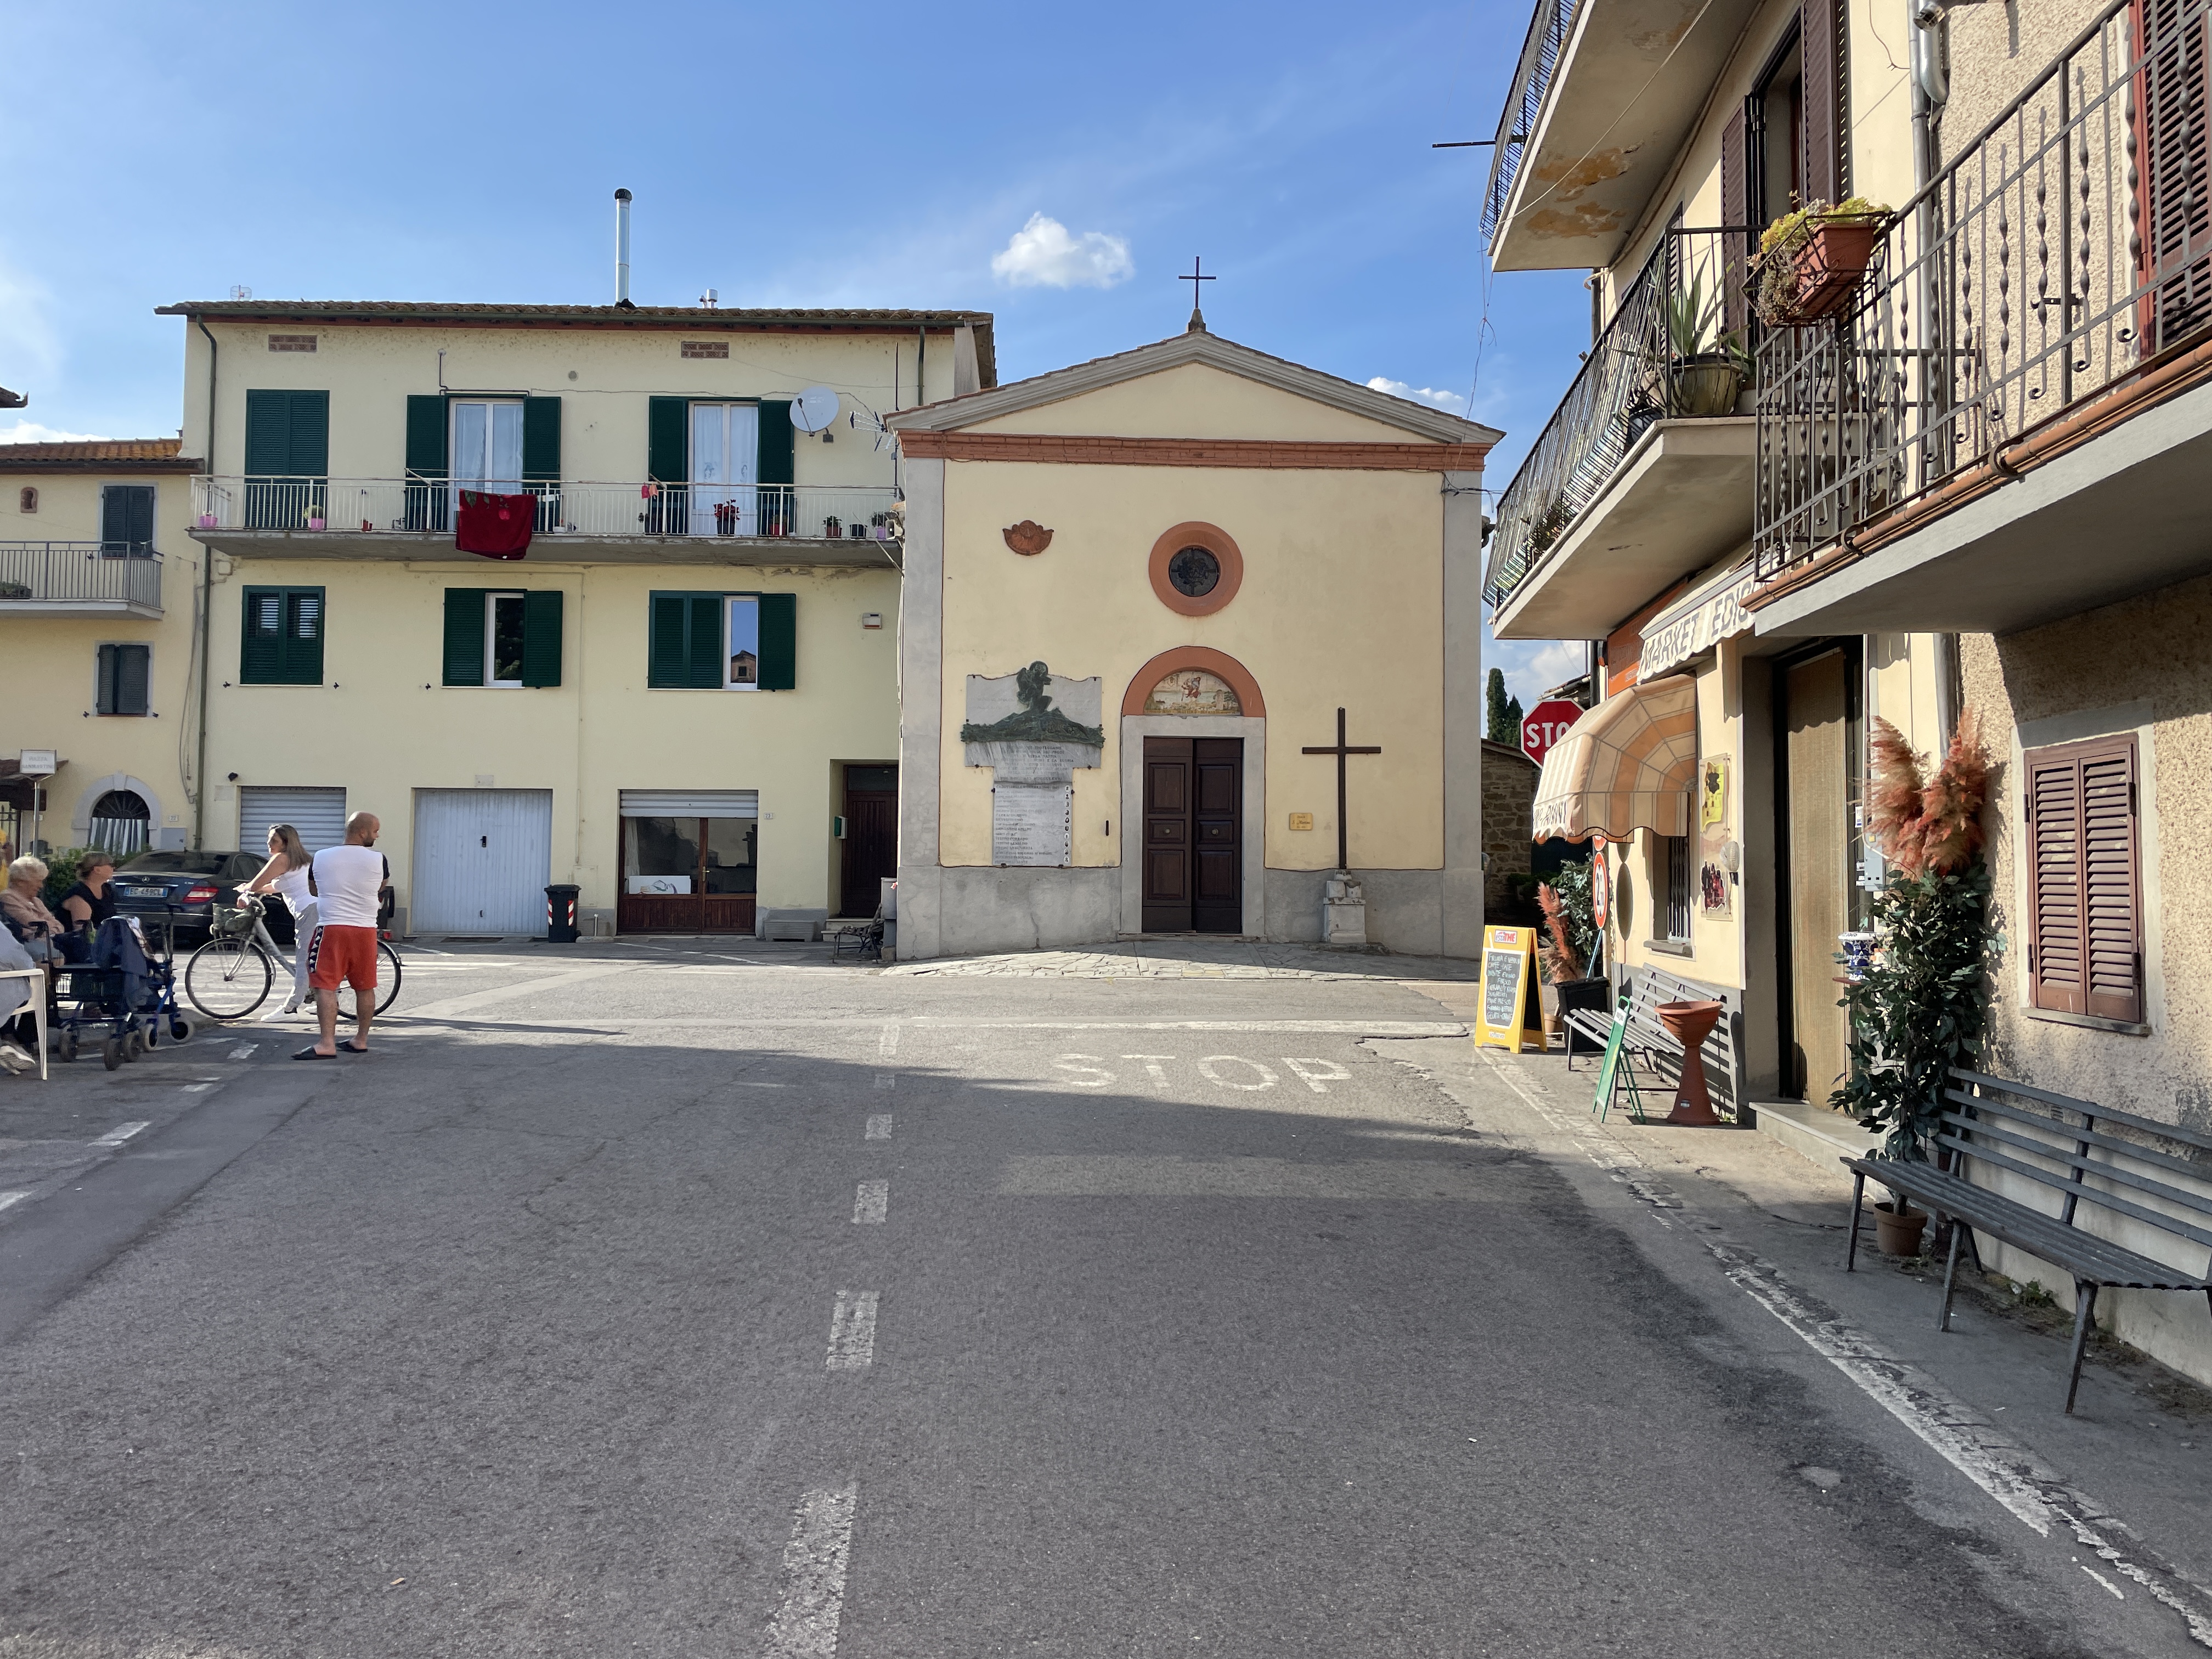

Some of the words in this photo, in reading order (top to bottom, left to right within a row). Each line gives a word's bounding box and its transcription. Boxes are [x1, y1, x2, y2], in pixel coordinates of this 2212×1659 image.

[1640, 612, 1699, 673] MARKET
[1526, 721, 1576, 748] STO
[1052, 1053, 1352, 1093] STOP
